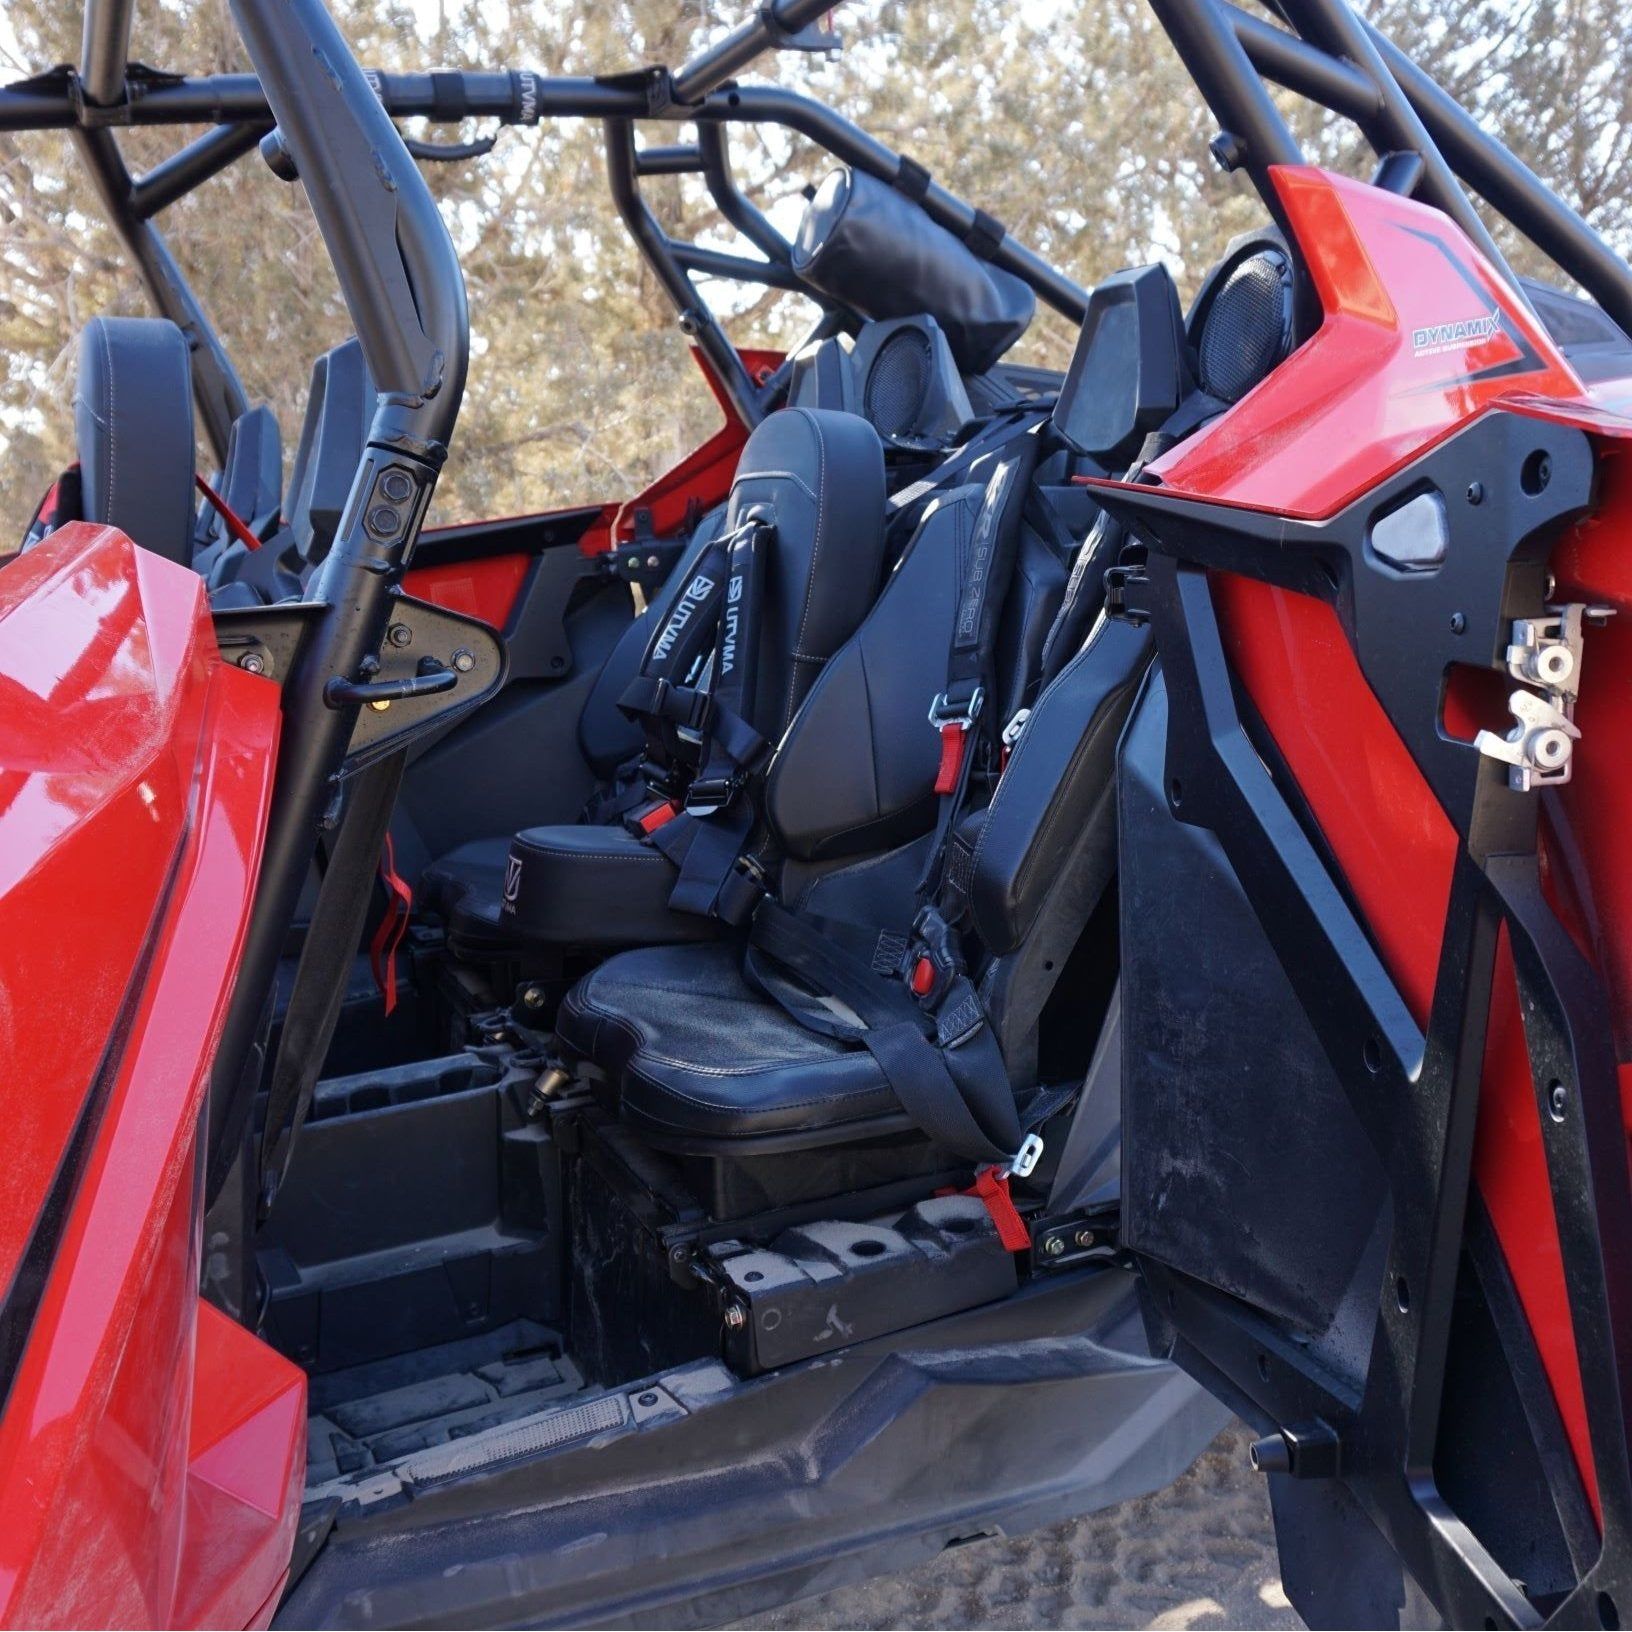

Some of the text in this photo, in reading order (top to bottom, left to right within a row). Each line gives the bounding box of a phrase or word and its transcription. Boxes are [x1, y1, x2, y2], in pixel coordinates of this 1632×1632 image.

[519, 71, 537, 121] UTVMA
[1413, 307, 1500, 348] DYNAMIX
[972, 546, 989, 582] SUB
[653, 601, 696, 660] UTVMA
[964, 586, 982, 634] ZERO
[721, 607, 740, 676] UTVMA
